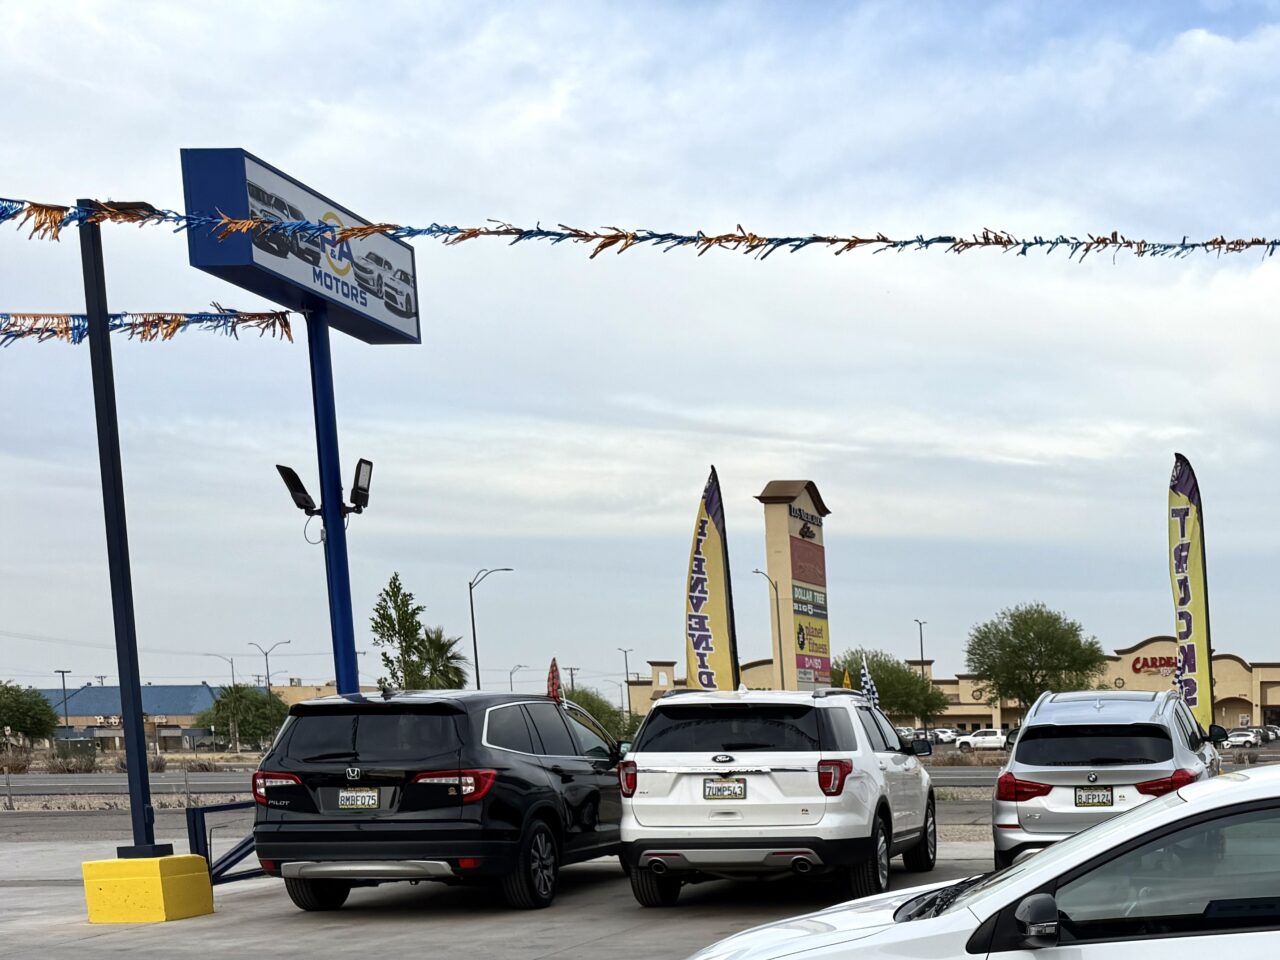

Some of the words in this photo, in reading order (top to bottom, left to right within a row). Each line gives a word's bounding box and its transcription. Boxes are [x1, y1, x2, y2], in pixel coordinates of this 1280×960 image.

[312, 266, 367, 308] MOTORS
[794, 586, 813, 602] DOLLAR
[813, 591, 825, 605] TREE
[793, 603, 807, 612] BIG
[807, 604, 814, 615] 5
[1132, 656, 1178, 674] CARDE
[706, 785, 743, 797] 7UMP543
